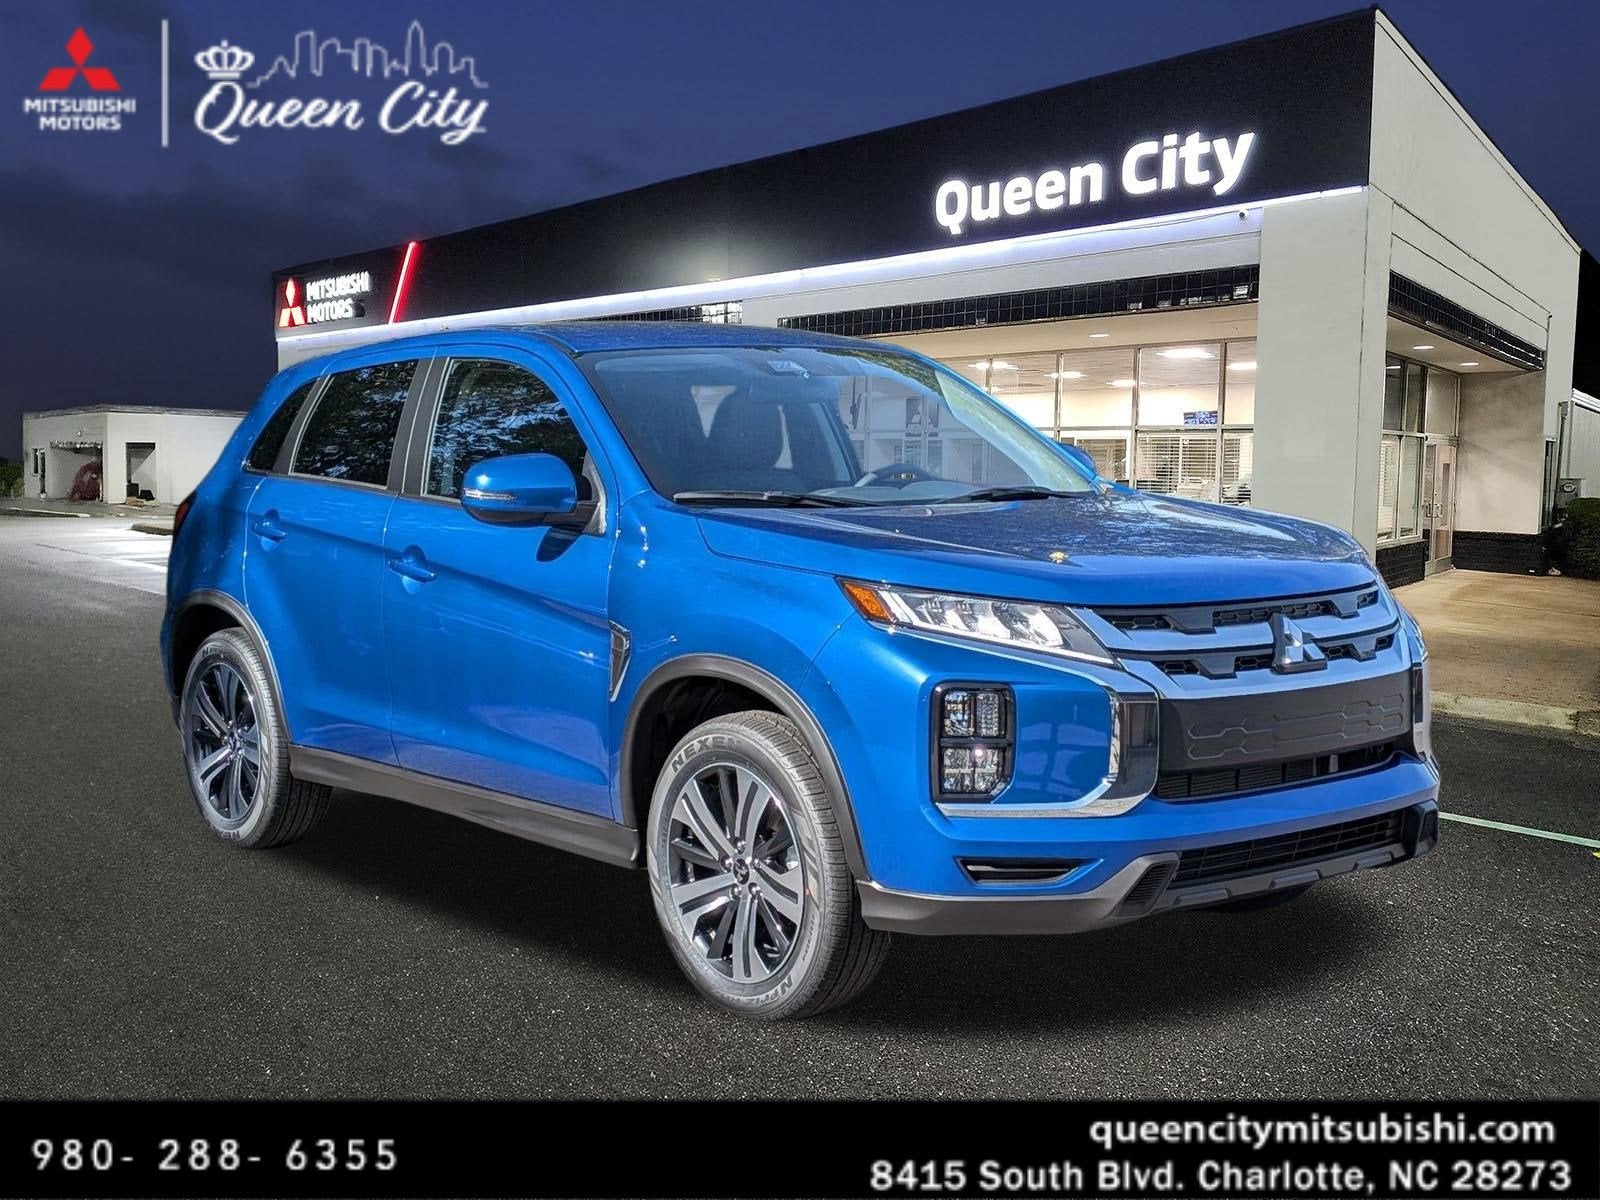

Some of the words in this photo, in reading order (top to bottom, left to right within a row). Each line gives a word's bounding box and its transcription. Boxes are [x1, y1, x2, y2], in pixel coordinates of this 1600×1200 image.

[935, 161, 1103, 235] Queen
[1121, 131, 1256, 196] City
[306, 270, 371, 302] MITSUBISHI
[306, 297, 355, 323] MOTORS
[671, 734, 737, 773] NEXEN
